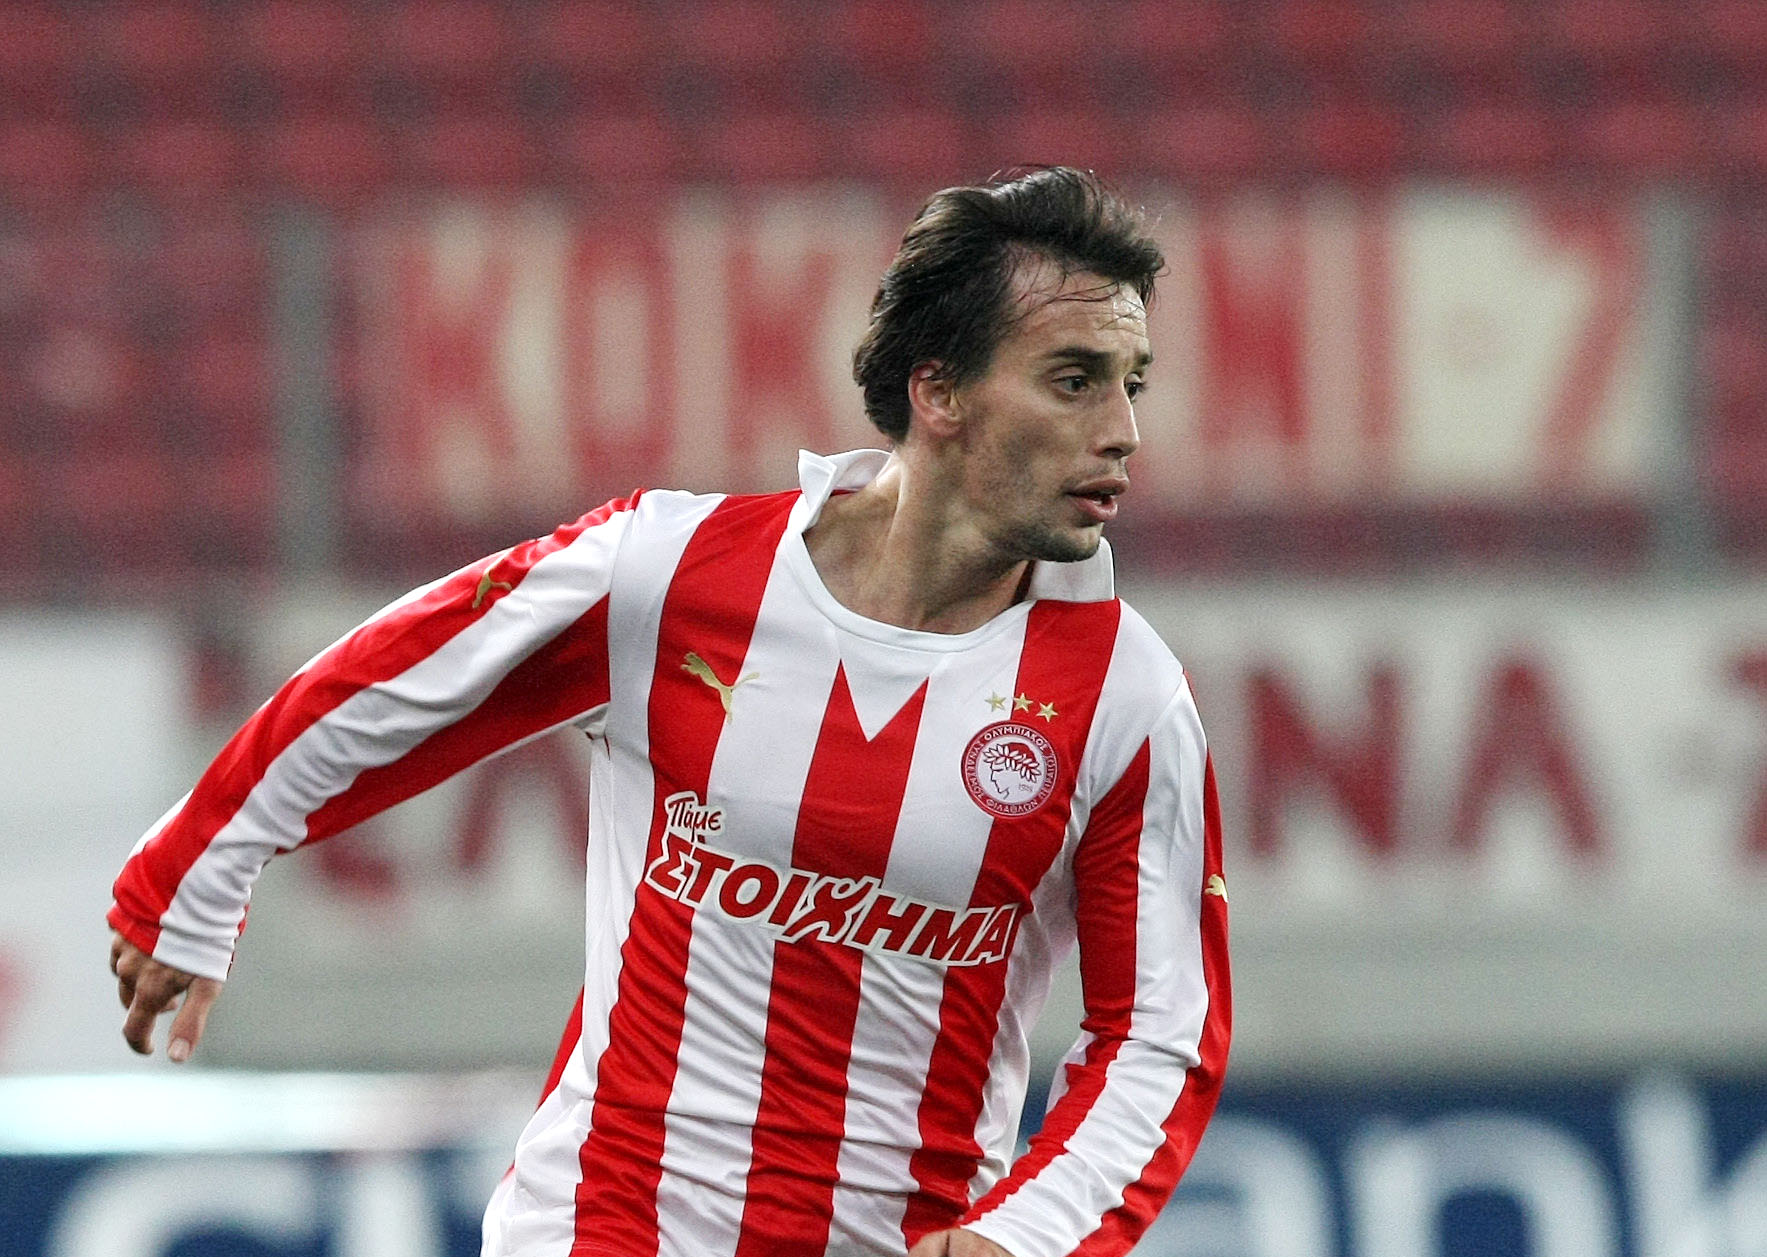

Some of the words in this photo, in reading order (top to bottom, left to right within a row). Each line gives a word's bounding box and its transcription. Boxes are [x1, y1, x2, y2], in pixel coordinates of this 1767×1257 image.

[984, 725, 1049, 754] ΟΛΥΜΠΙΑΚΟΣ
[666, 794, 723, 843] Πάμε
[646, 832, 1018, 965] ΣΤΟΙΧΗΜΑ
